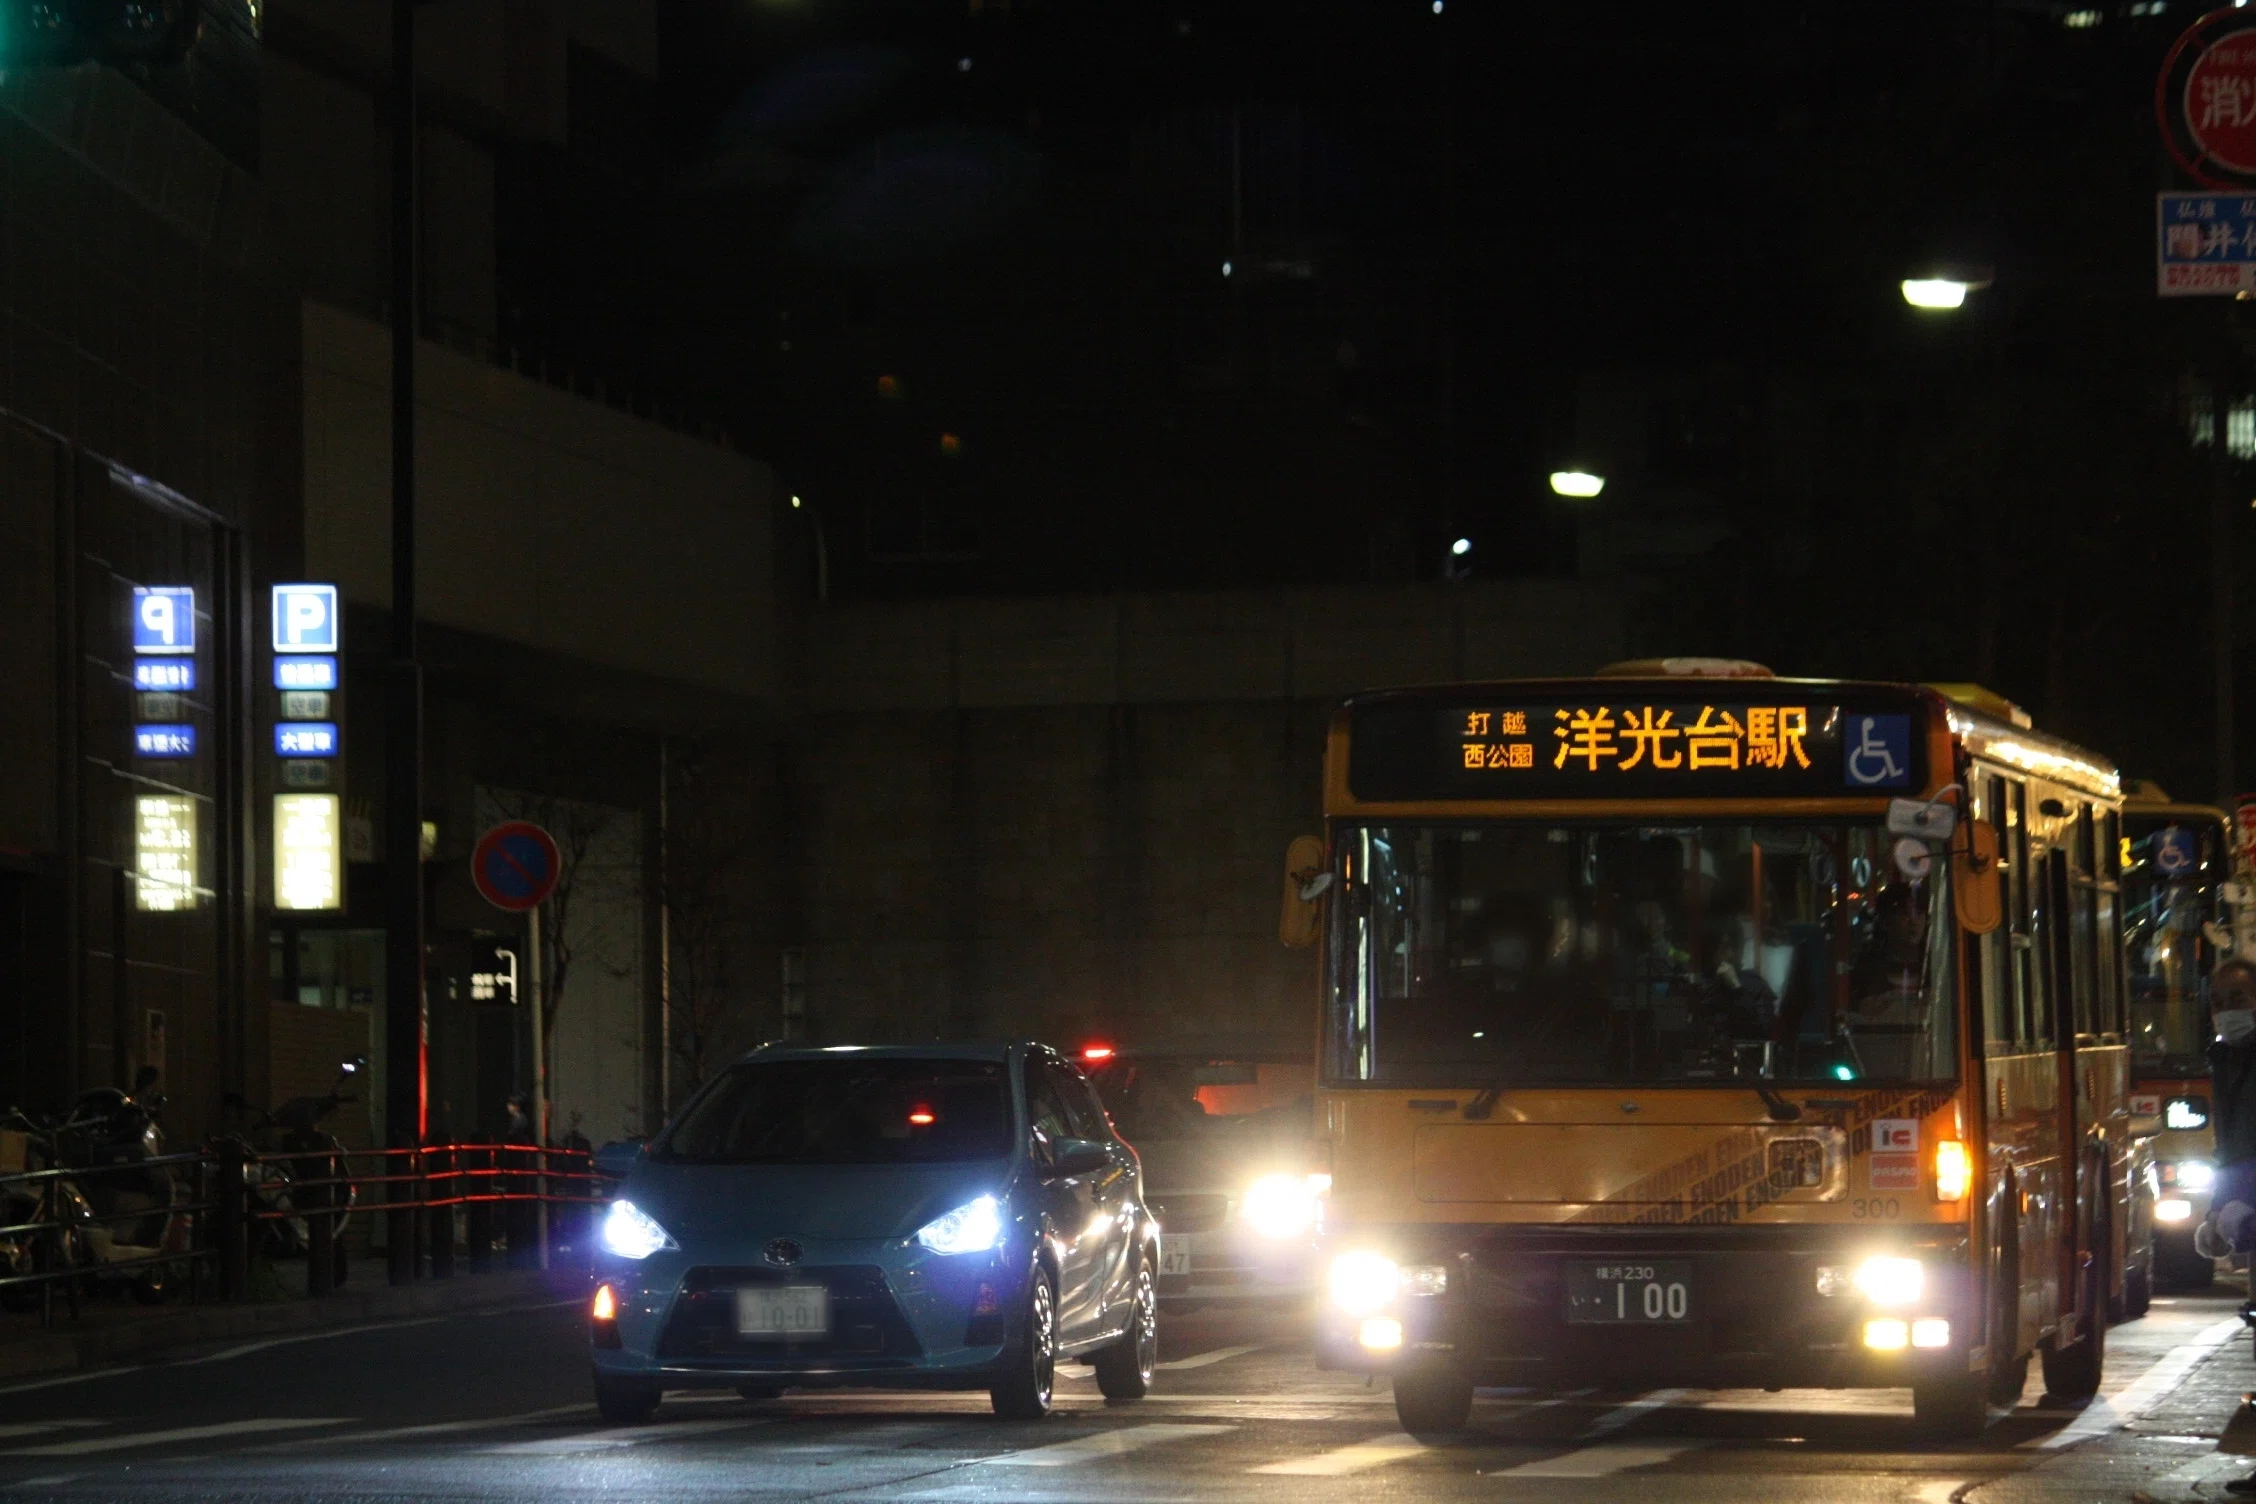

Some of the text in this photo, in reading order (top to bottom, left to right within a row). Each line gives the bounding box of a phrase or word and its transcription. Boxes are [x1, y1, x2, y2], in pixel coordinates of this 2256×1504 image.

[287, 593, 326, 645] P
[1467, 711, 1526, 735] 打越
[1554, 706, 1811, 771] 洋光台駅
[1463, 744, 1533, 768] 西公園
[1852, 1197, 1900, 1219] 300
